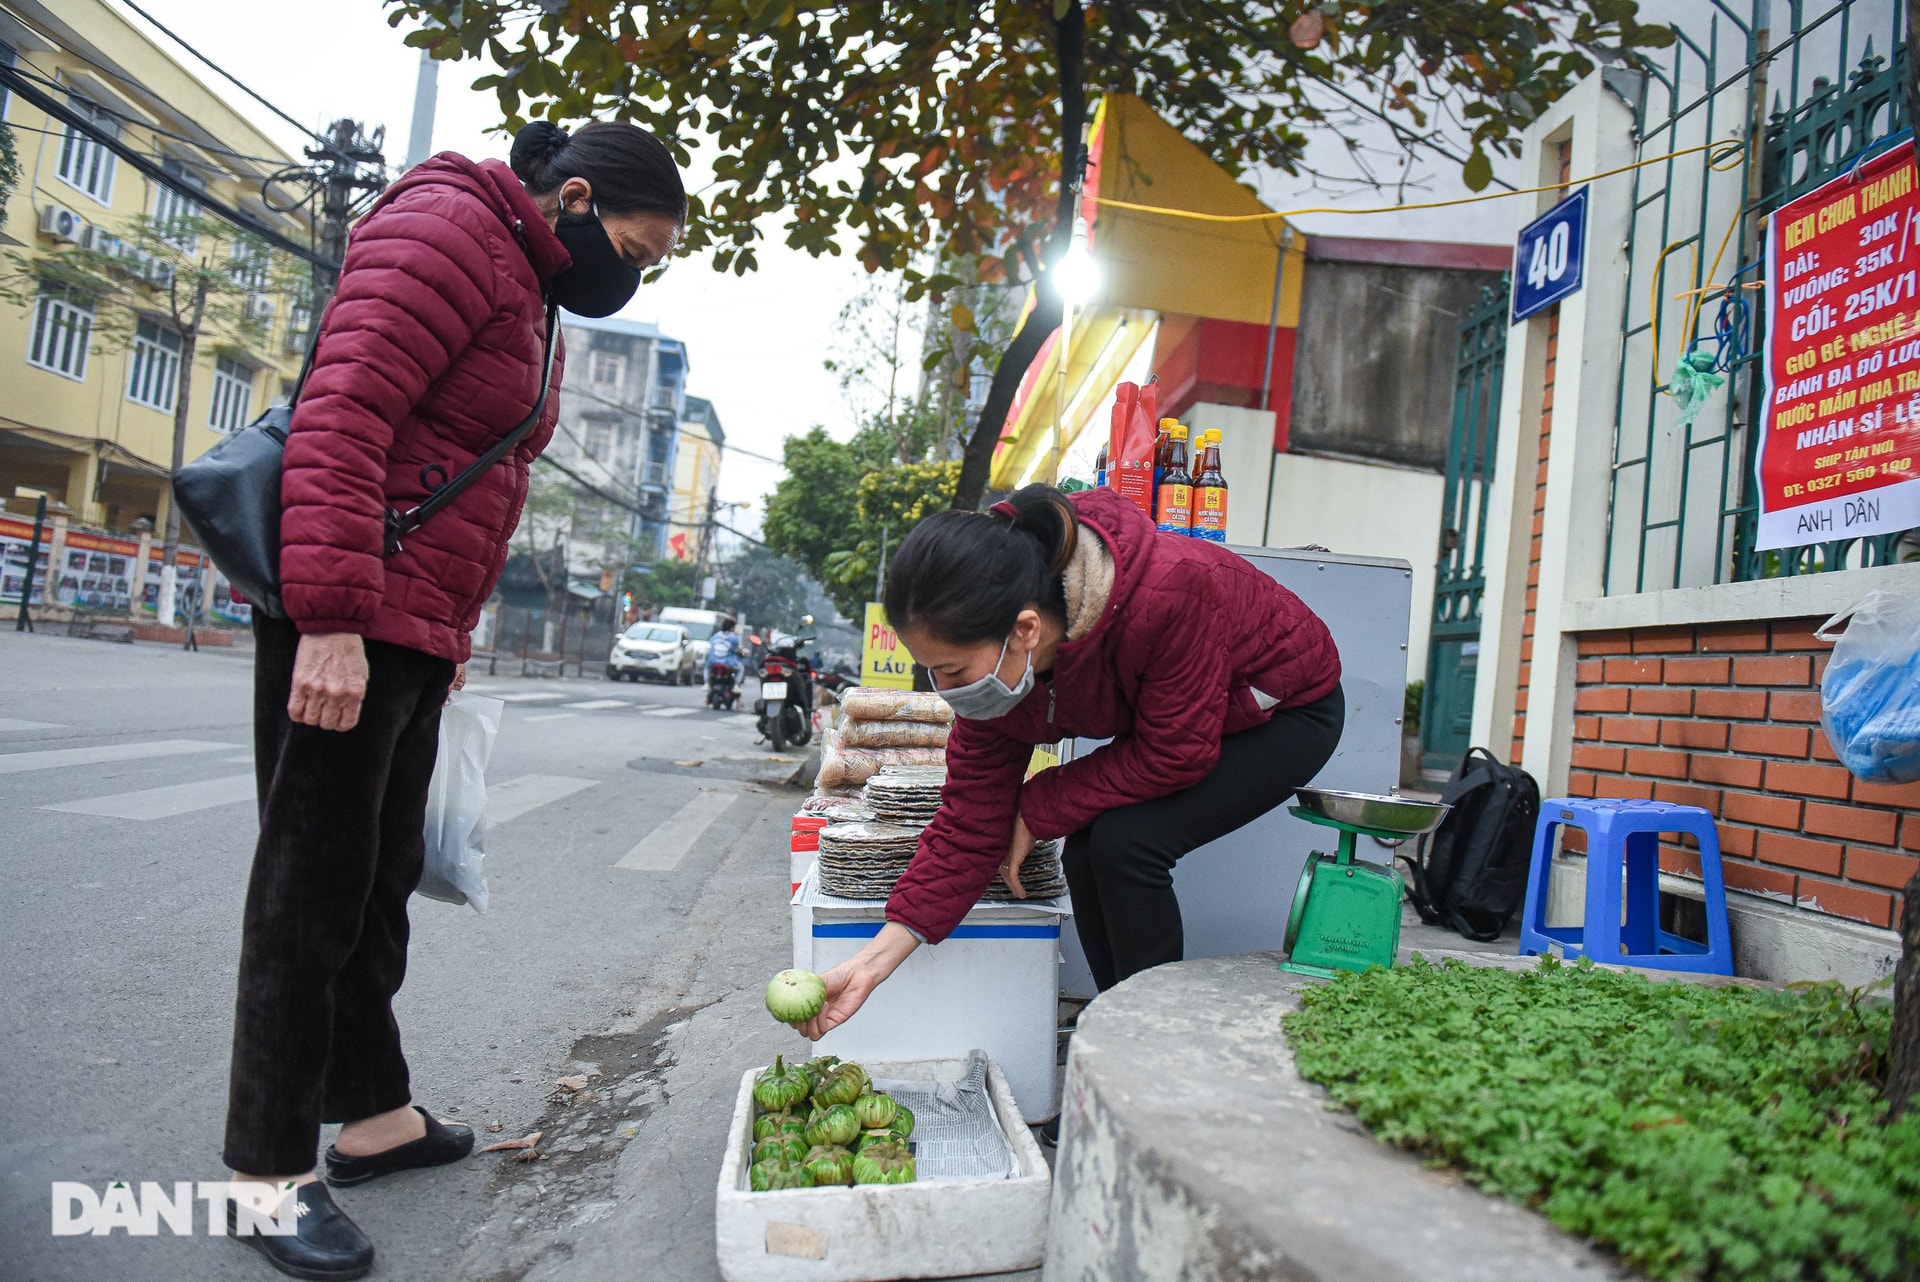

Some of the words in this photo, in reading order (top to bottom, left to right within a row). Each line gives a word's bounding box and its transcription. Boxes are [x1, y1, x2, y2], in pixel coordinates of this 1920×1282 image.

[1785, 212, 1816, 251] NEM
[1818, 193, 1856, 234] CHUA
[1861, 165, 1911, 214] THANH
[1527, 221, 1569, 291] 40
[1783, 251, 1820, 282] DÀI:
[1859, 211, 1899, 246] 30K
[1783, 267, 1850, 310] VUÔNG:
[1854, 243, 1894, 277] 35K
[1791, 298, 1838, 342] CỐI:
[1775, 373, 1824, 405] BÁNH
[1827, 364, 1852, 388] ĐA
[1856, 350, 1884, 378] ĐÔ
[1786, 346, 1817, 375] GIÒ
[1821, 335, 1846, 363] BÊ
[1776, 402, 1816, 430] NƯỚC
[1818, 388, 1857, 417] MẮM
[1860, 378, 1893, 405] NHA
[1796, 417, 1854, 450] NHẬN
[1860, 403, 1884, 432] SỈ
[1807, 473, 1842, 492] 0327
[1814, 453, 1842, 469] SHIP
[1797, 509, 1832, 534] ANH
[1844, 496, 1880, 527] DÂN
